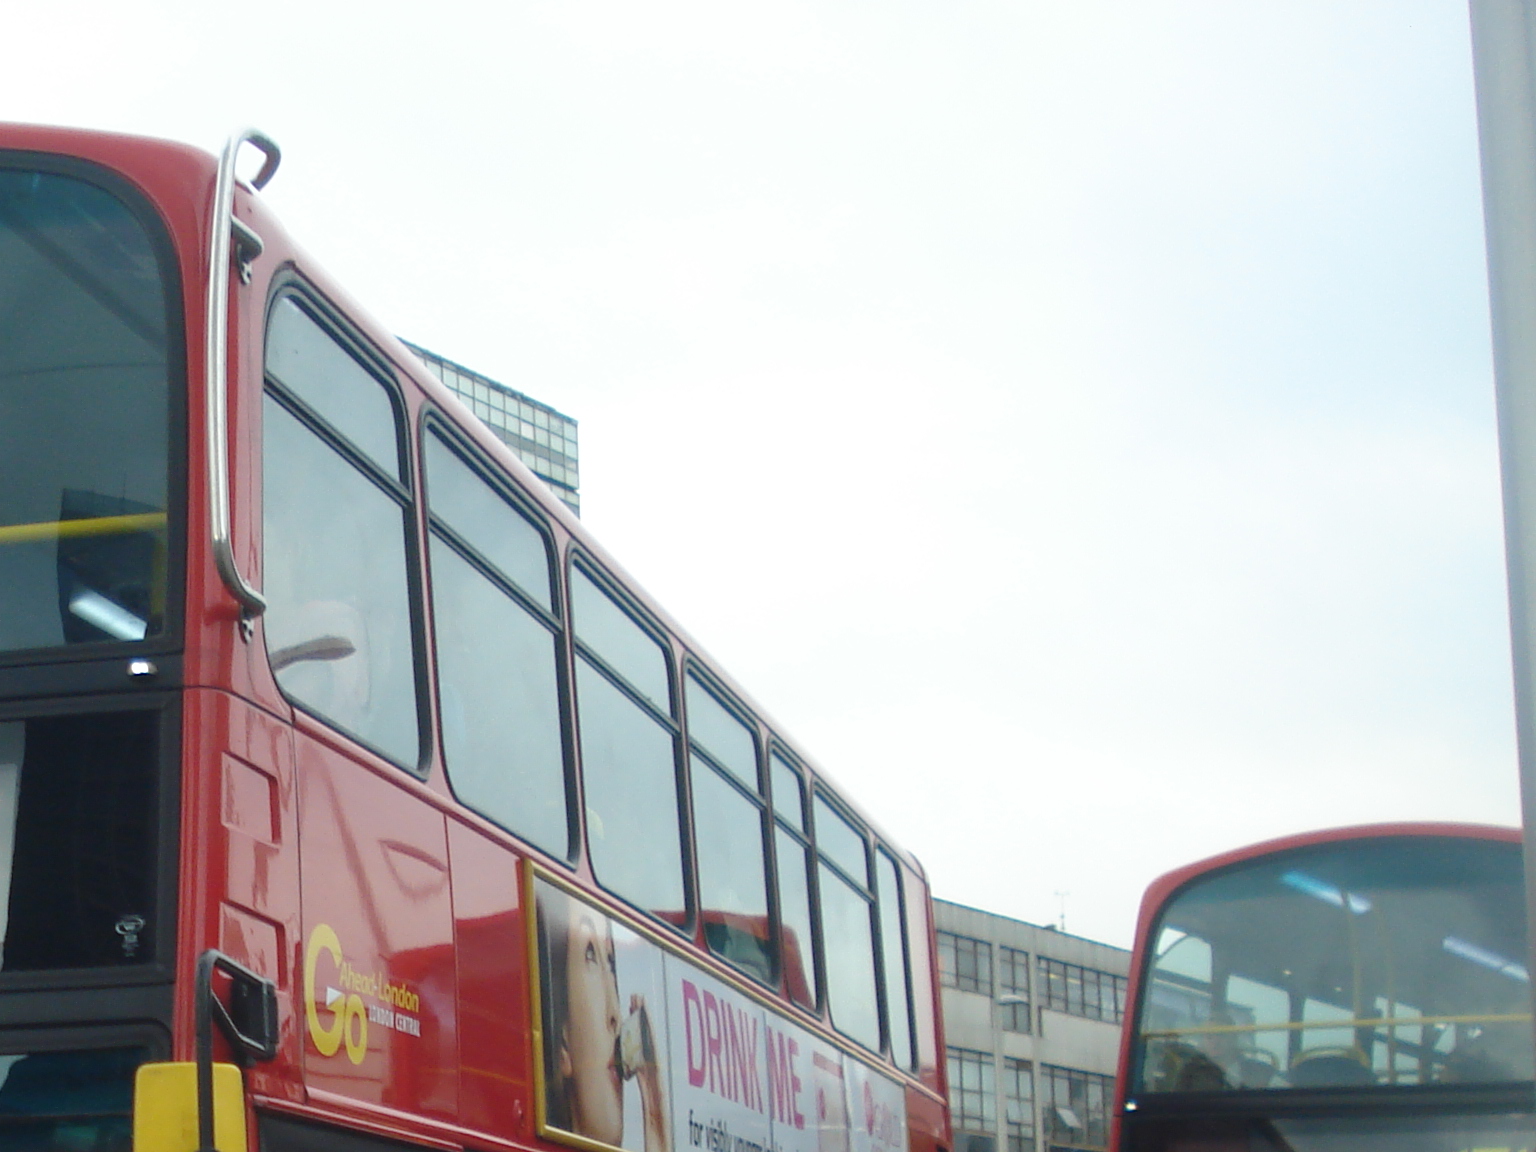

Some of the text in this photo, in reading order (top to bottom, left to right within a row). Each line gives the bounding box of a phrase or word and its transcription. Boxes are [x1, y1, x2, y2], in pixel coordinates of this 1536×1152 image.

[304, 923, 367, 1065] Go
[682, 977, 805, 1131] DRINK ME
[688, 1108, 703, 1149] for
